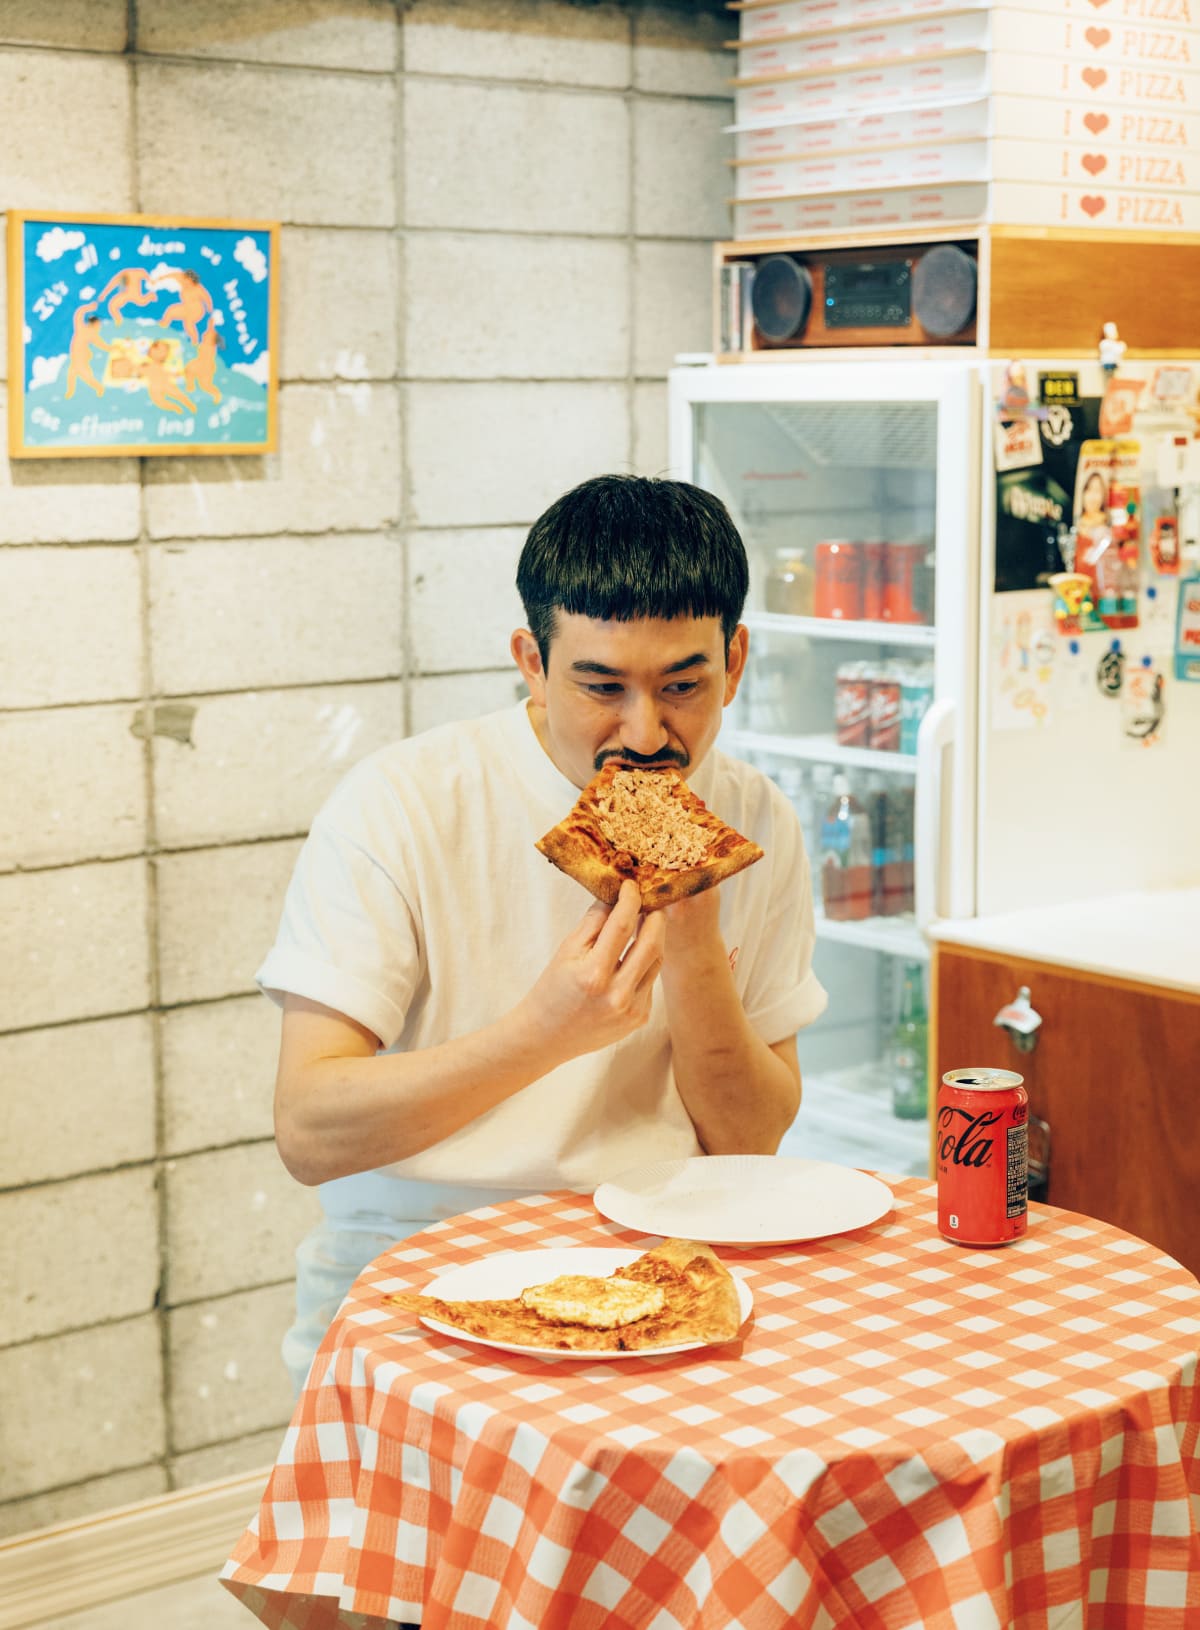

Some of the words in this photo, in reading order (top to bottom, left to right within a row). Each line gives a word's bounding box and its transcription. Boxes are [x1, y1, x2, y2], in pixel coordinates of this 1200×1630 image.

[1064, 23, 1072, 49] I
[1122, 30, 1191, 62] PIZZA
[1061, 63, 1070, 90] I
[1119, 69, 1187, 102] PIZZA
[1063, 108, 1072, 136] I
[1119, 114, 1188, 144] PIZZA
[1061, 150, 1070, 177] I
[1118, 154, 1187, 184] PIZZA
[1060, 192, 1069, 219] I
[1116, 195, 1184, 224] PIZZA
